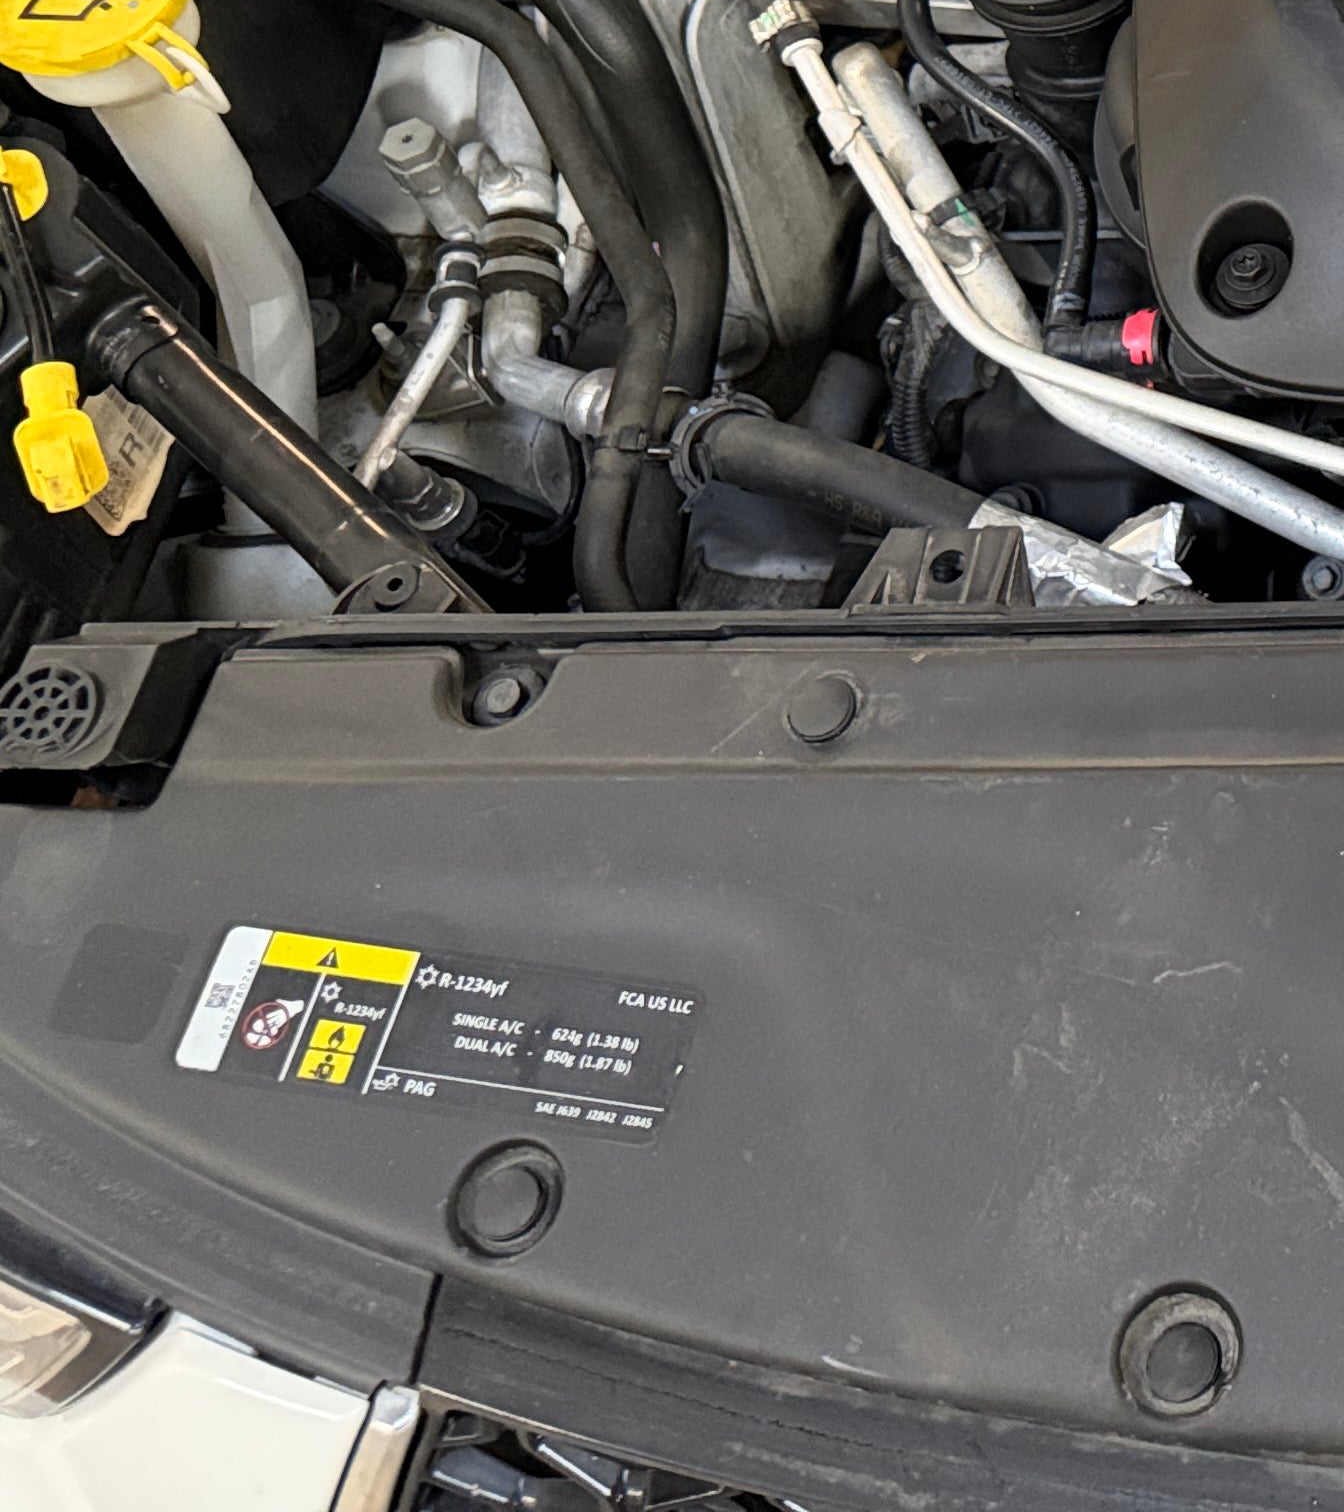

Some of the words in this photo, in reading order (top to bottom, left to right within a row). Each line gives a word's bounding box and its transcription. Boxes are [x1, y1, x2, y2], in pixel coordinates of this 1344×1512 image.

[119, 432, 143, 461] R
[438, 972, 510, 999] R-1234yf
[334, 1003, 386, 1021] R-1234yf
[618, 990, 645, 1008] FCA
[647, 993, 668, 1011] US
[668, 997, 695, 1015] LLC
[452, 1013, 498, 1031] SINGLE
[498, 1020, 525, 1035] A/C
[551, 1027, 583, 1046] 624g
[619, 1037, 640, 1054] lb)
[454, 1035, 490, 1054] DUAL
[490, 1041, 518, 1057] A/C
[544, 1049, 576, 1069] 850g
[612, 1058, 632, 1076] lb)
[403, 1079, 437, 1098] PAG
[534, 1101, 555, 1115] SAE
